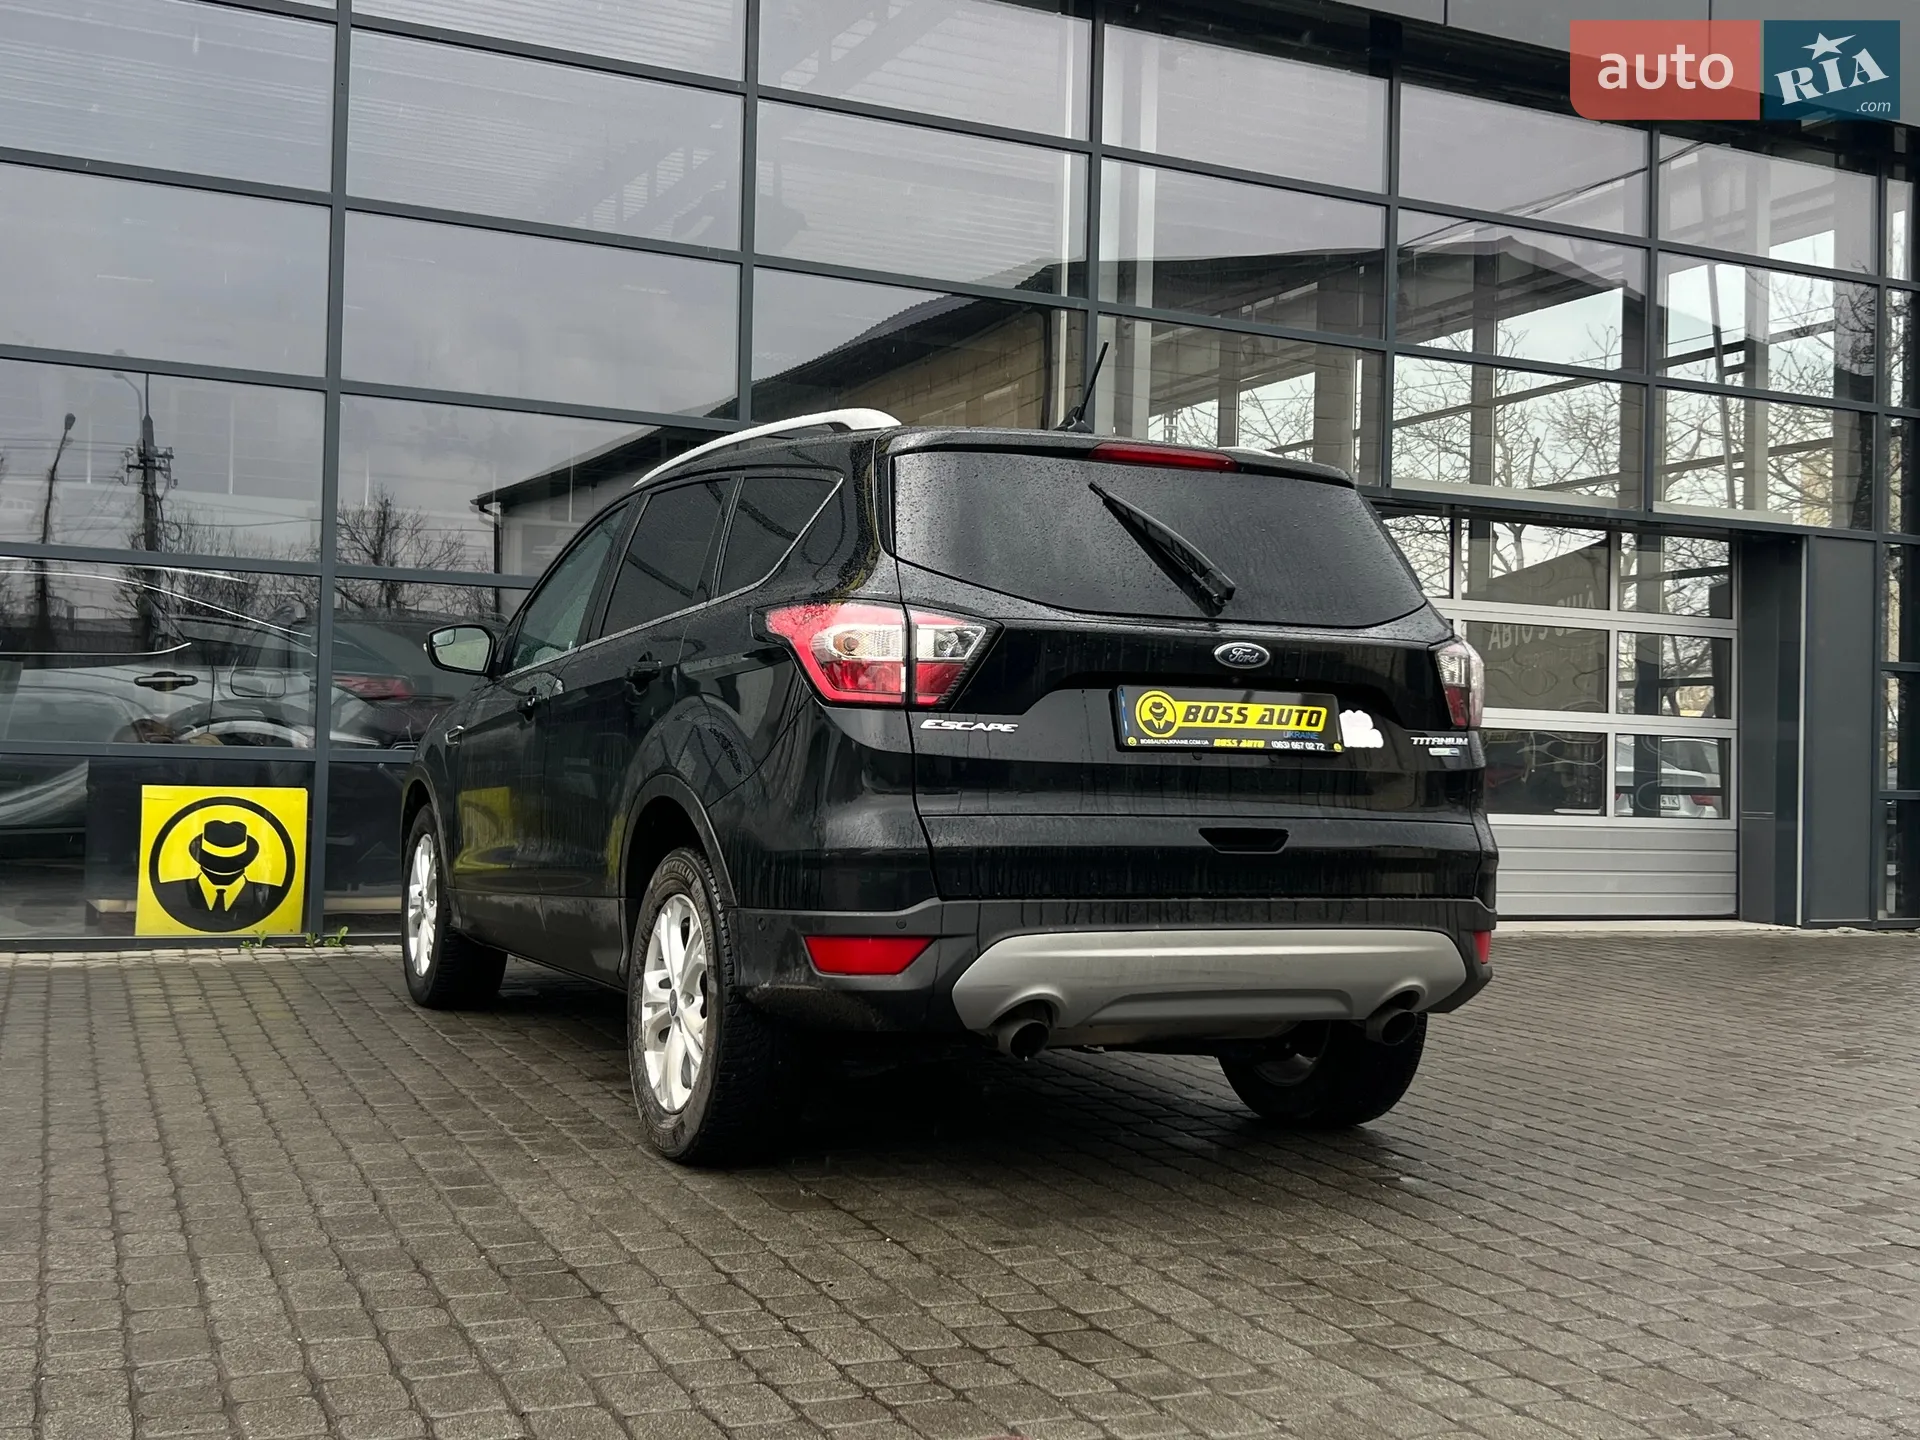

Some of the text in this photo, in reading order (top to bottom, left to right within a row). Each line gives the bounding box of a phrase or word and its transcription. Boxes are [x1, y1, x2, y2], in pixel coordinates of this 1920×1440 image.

[1229, 647, 1259, 662] Ford
[1183, 704, 1322, 727] BOSS AUTO
[920, 719, 1018, 732] ESCAPE
[1283, 730, 1319, 740] UKRAINE
[1213, 738, 1265, 748] BOSS AUTO
[1410, 737, 1468, 746] TITANIUM
